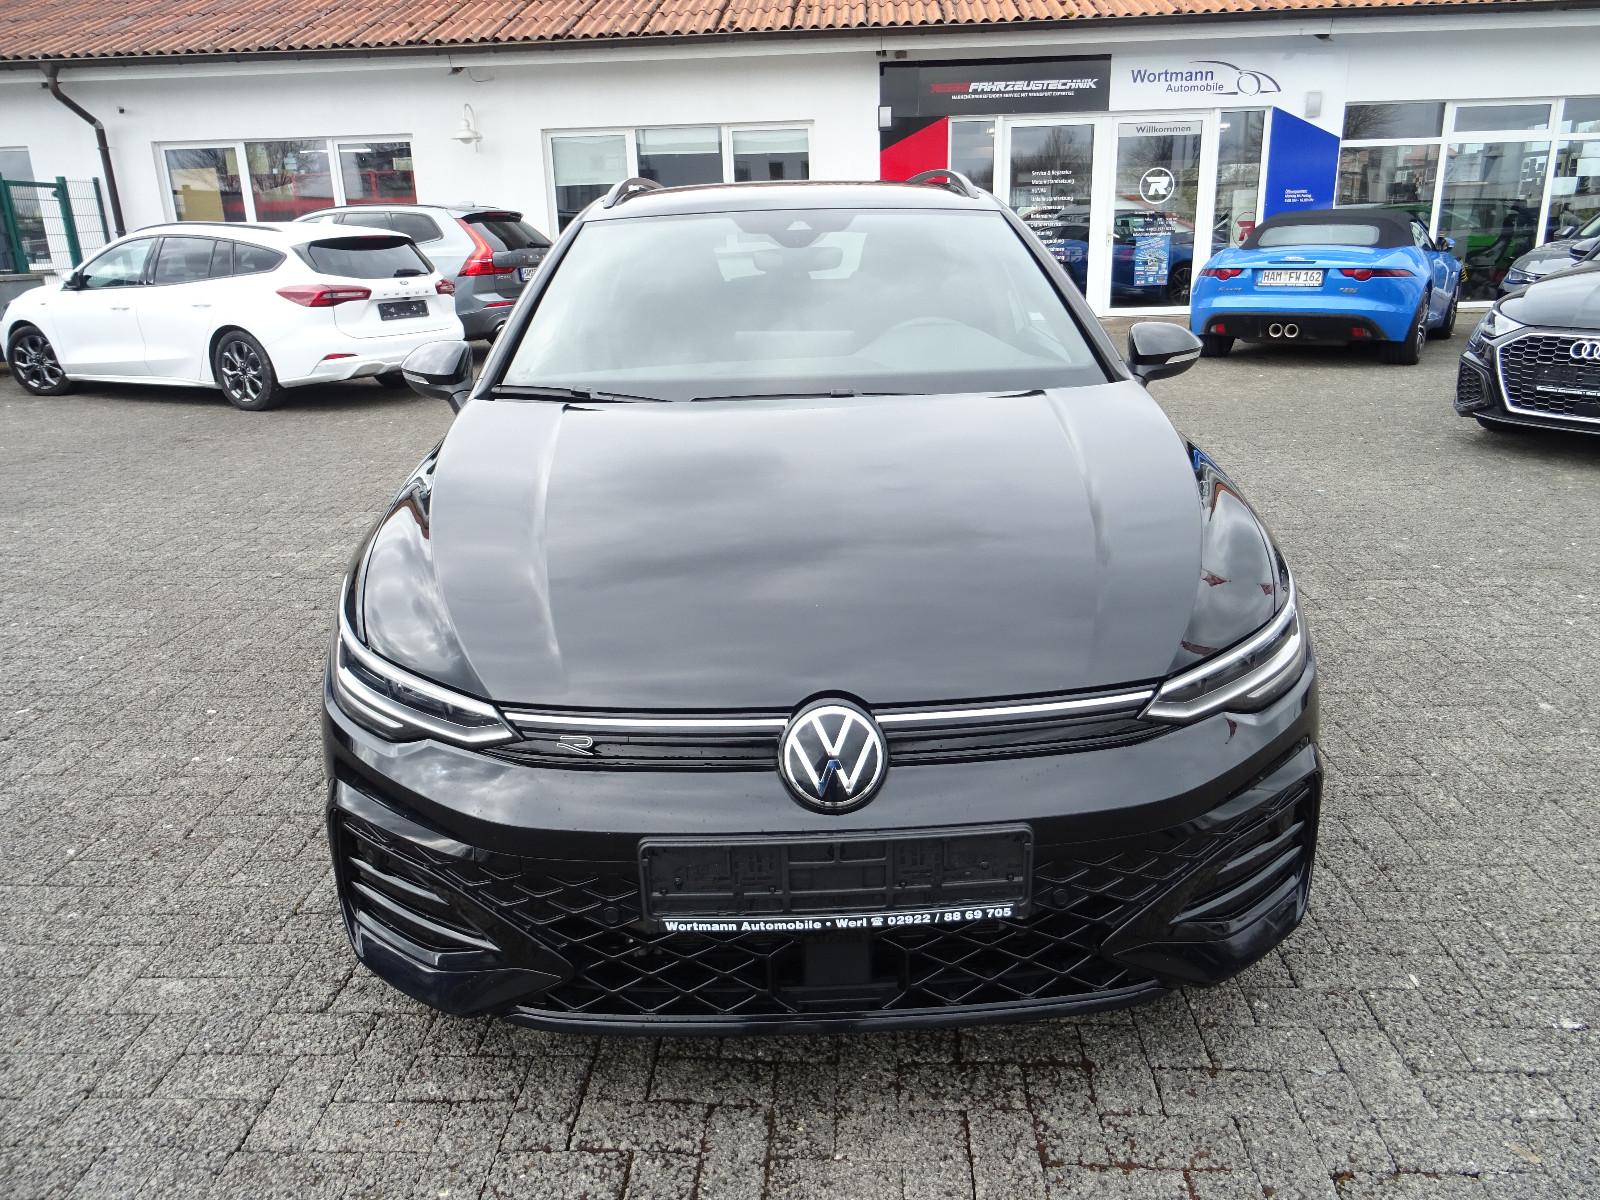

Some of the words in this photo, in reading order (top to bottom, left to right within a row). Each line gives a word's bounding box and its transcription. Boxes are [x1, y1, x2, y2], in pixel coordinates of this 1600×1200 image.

[1132, 69, 1214, 83] Wortmann
[968, 79, 1099, 92] FAHRZEUGTECHNIK
[1166, 83, 1224, 92] Automobile
[1136, 126, 1191, 134] Willkommen
[1263, 271, 1282, 282] HAM
[1288, 271, 1300, 282] FW
[1303, 271, 1322, 282] 162
[665, 921, 736, 931] Wortmann
[741, 920, 822, 931] Automobile
[836, 917, 867, 928] Werl
[887, 914, 931, 926] 02922
[944, 912, 961, 922] 88
[965, 909, 982, 920] 69
[986, 908, 1012, 918] 705
